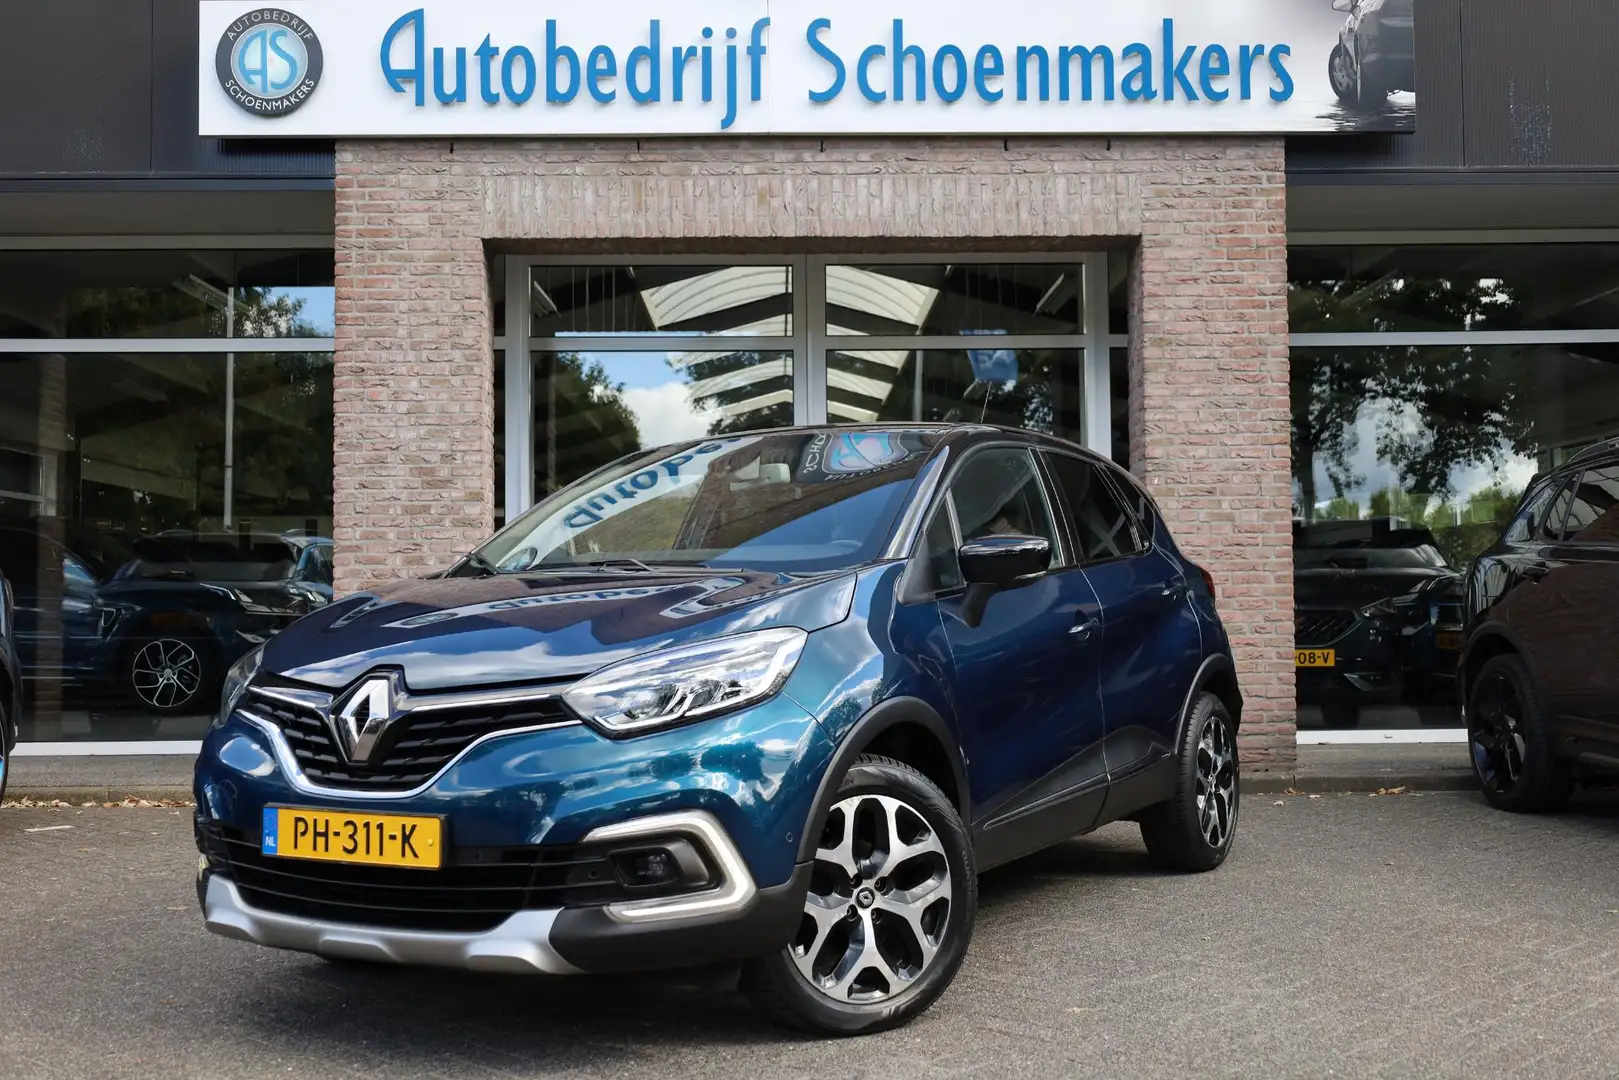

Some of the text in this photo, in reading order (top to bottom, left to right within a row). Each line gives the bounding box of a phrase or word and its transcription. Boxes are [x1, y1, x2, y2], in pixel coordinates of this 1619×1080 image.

[227, 10, 314, 41] AUTOBEDRIJF
[238, 30, 298, 94] AS
[380, 8, 1294, 129] Autobedrijf Schoenmakers
[225, 79, 315, 111] SCHOENMAKERS
[265, 836, 277, 847] NL
[293, 816, 420, 860] PH-311-K
